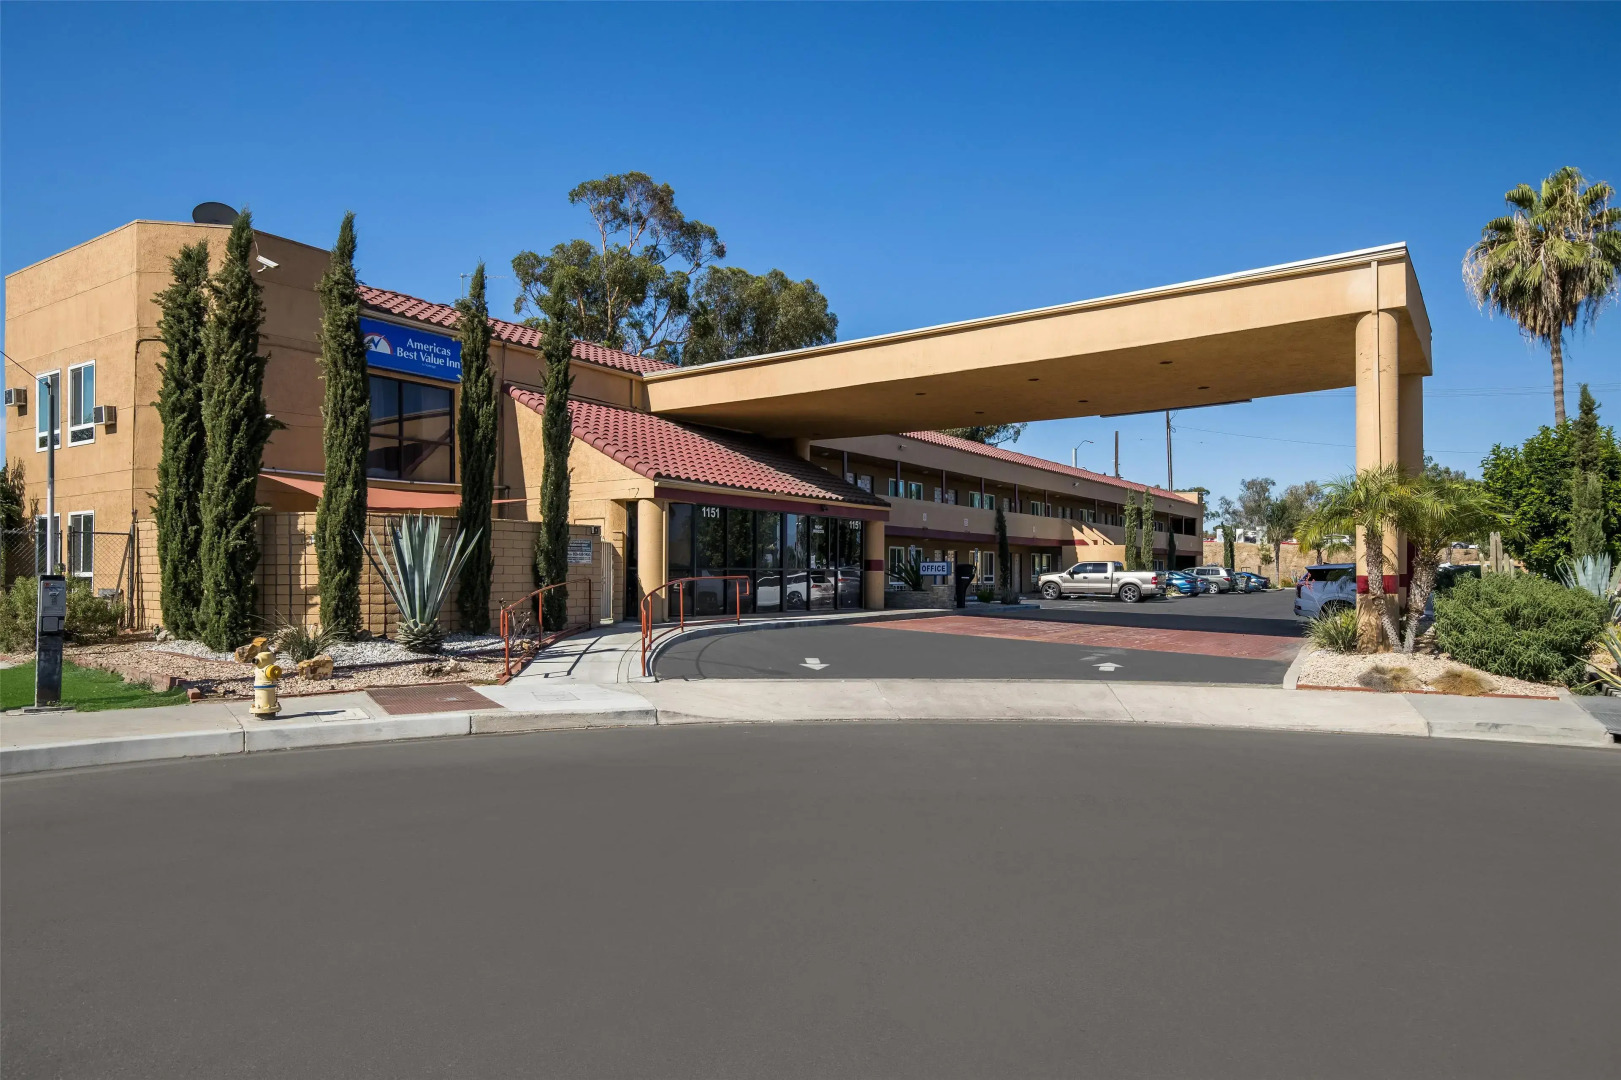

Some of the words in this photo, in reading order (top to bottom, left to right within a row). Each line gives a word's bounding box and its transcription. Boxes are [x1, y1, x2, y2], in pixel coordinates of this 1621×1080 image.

[406, 338, 451, 357] Americas
[397, 347, 418, 360] Best
[420, 351, 445, 366] Value
[446, 357, 461, 369] Inn
[702, 507, 720, 518] 1151
[849, 520, 862, 529] 1151
[921, 564, 946, 572] OFFICE
